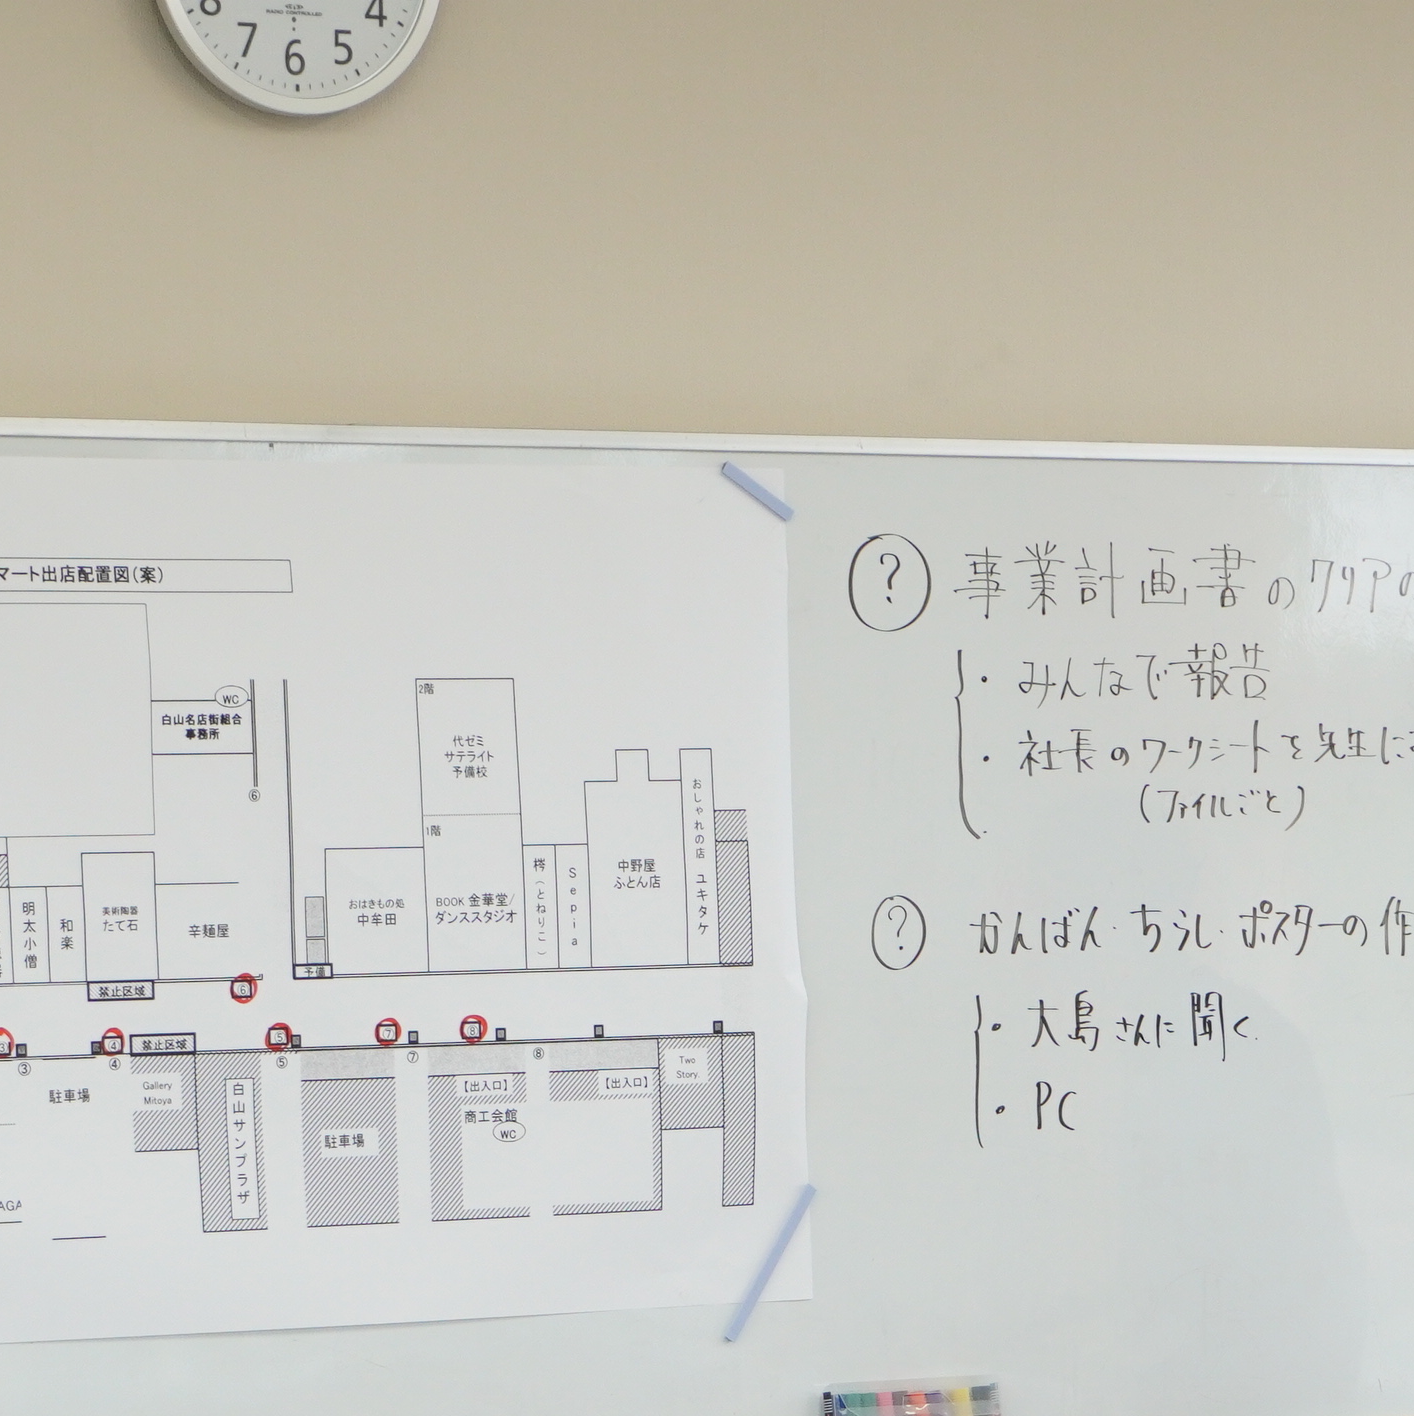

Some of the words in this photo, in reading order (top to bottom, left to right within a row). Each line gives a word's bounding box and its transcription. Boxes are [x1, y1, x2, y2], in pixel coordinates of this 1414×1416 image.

[365, 0, 387, 27] 4
[237, 22, 258, 57] 7
[334, 29, 354, 65] 5
[285, 39, 306, 75] 6
[419, 683, 434, 694] 2階
[222, 694, 240, 704] WC
[161, 713, 243, 726] 白山名店街組合
[185, 727, 220, 740] 事務所
[452, 735, 484, 747] 代ゼミ
[444, 751, 494, 763] サテライト
[452, 766, 488, 778] 予備校
[693, 778, 705, 859] おしゃれの店
[425, 825, 441, 837] 1階
[617, 858, 656, 873] 中野屋
[613, 875, 661, 889] ふとん店
[348, 898, 405, 909] おはきもの処
[436, 896, 465, 907] BOOK
[569, 867, 578, 946] Sepia
[696, 873, 709, 935] ユキタケ
[102, 906, 138, 916] 美術陶器
[435, 909, 518, 925] ダンススタジオ
[103, 919, 138, 932] たて石
[357, 913, 397, 926] 中牟田
[22, 902, 38, 969] 明太小僧
[60, 919, 74, 950] 和楽
[304, 967, 325, 977] 予備
[99, 985, 147, 998] 禁止区域
[142, 1038, 188, 1051] 禁止区域
[680, 1055, 696, 1065] Two
[142, 1081, 172, 1092] Gallery
[49, 1089, 91, 1104] 駐車場
[143, 1096, 172, 1106] Mitoya
[1035, 1080, 1077, 1131] PC
[464, 1108, 518, 1124] 商工会館
[500, 1130, 516, 1139] WC
[232, 1083, 250, 1204] 白山サンプラザ
[324, 1134, 365, 1149] 駐車場
